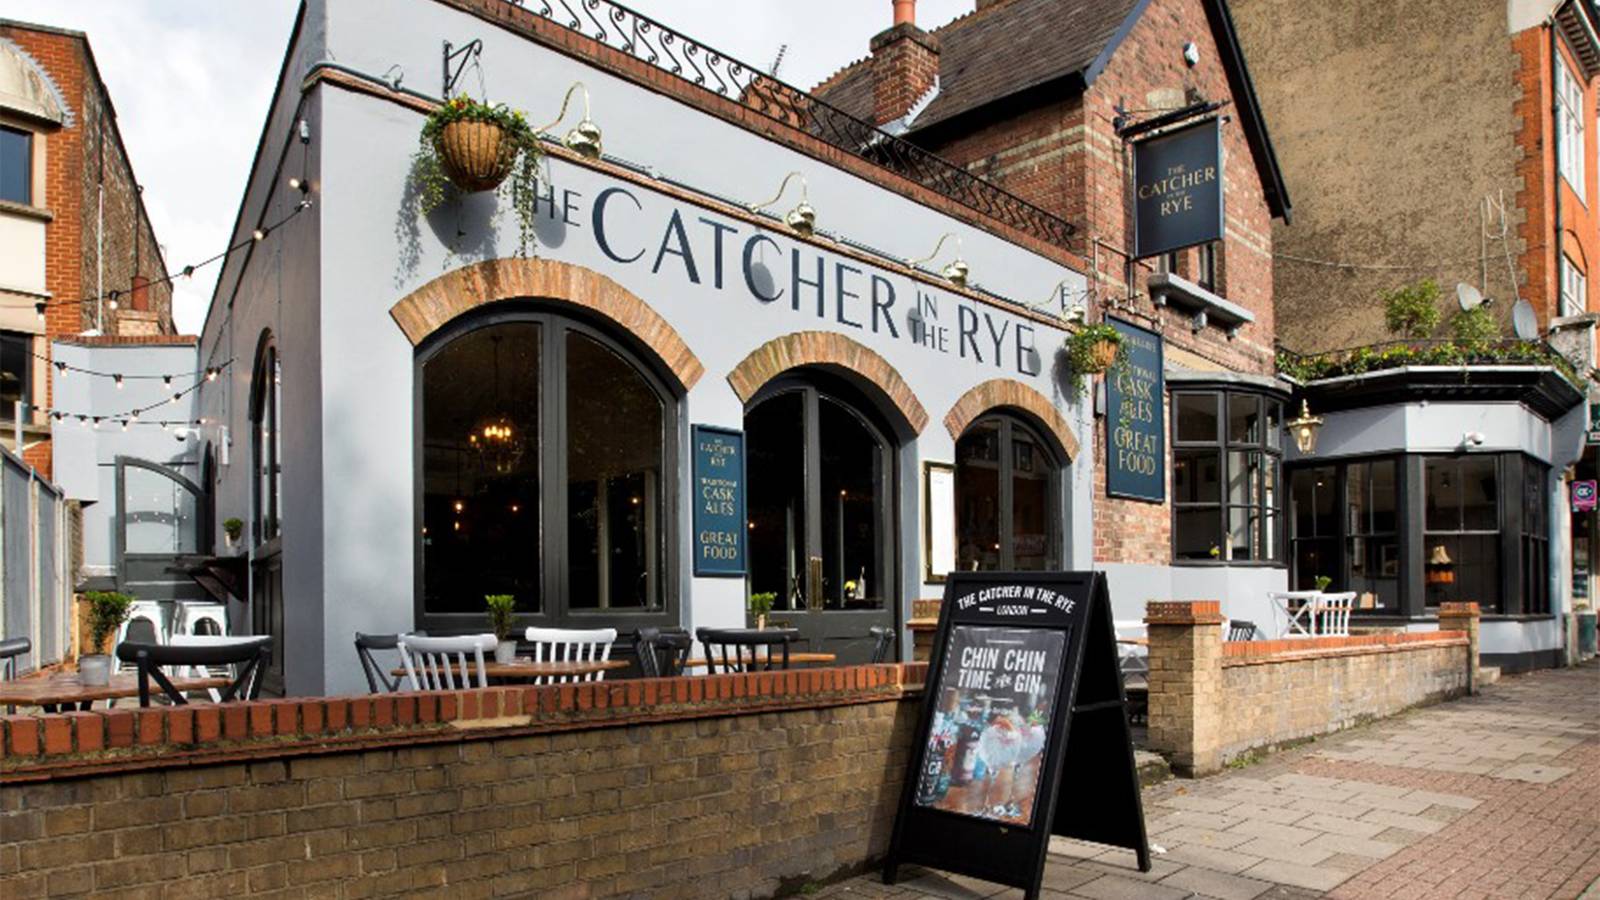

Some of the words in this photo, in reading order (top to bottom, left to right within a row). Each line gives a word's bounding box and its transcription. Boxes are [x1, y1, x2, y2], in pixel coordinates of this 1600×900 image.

[1139, 166, 1215, 200] CATCHER
[1160, 195, 1193, 217] RYE
[592, 187, 900, 339] CATCHER
[916, 290, 938, 320] IN
[908, 317, 949, 353] THE
[958, 303, 1037, 377] RYE
[1114, 427, 1157, 454] GREAT
[1119, 449, 1156, 476] FOOD
[703, 486, 736, 502] CASK
[704, 501, 735, 516] ALES
[700, 530, 737, 546] GREAT
[703, 545, 737, 560] FOOD
[957, 592, 977, 611] THE
[979, 585, 1023, 602] CATCHER
[1023, 586, 1036, 600] IN
[1036, 587, 1057, 605] THE
[1053, 594, 1077, 614] RYE
[996, 604, 1030, 616] LONDON
[961, 646, 1000, 670] CHIN
[1003, 649, 1047, 673] CHIN
[957, 668, 994, 690] TIME
[1013, 673, 1042, 694] GIN
